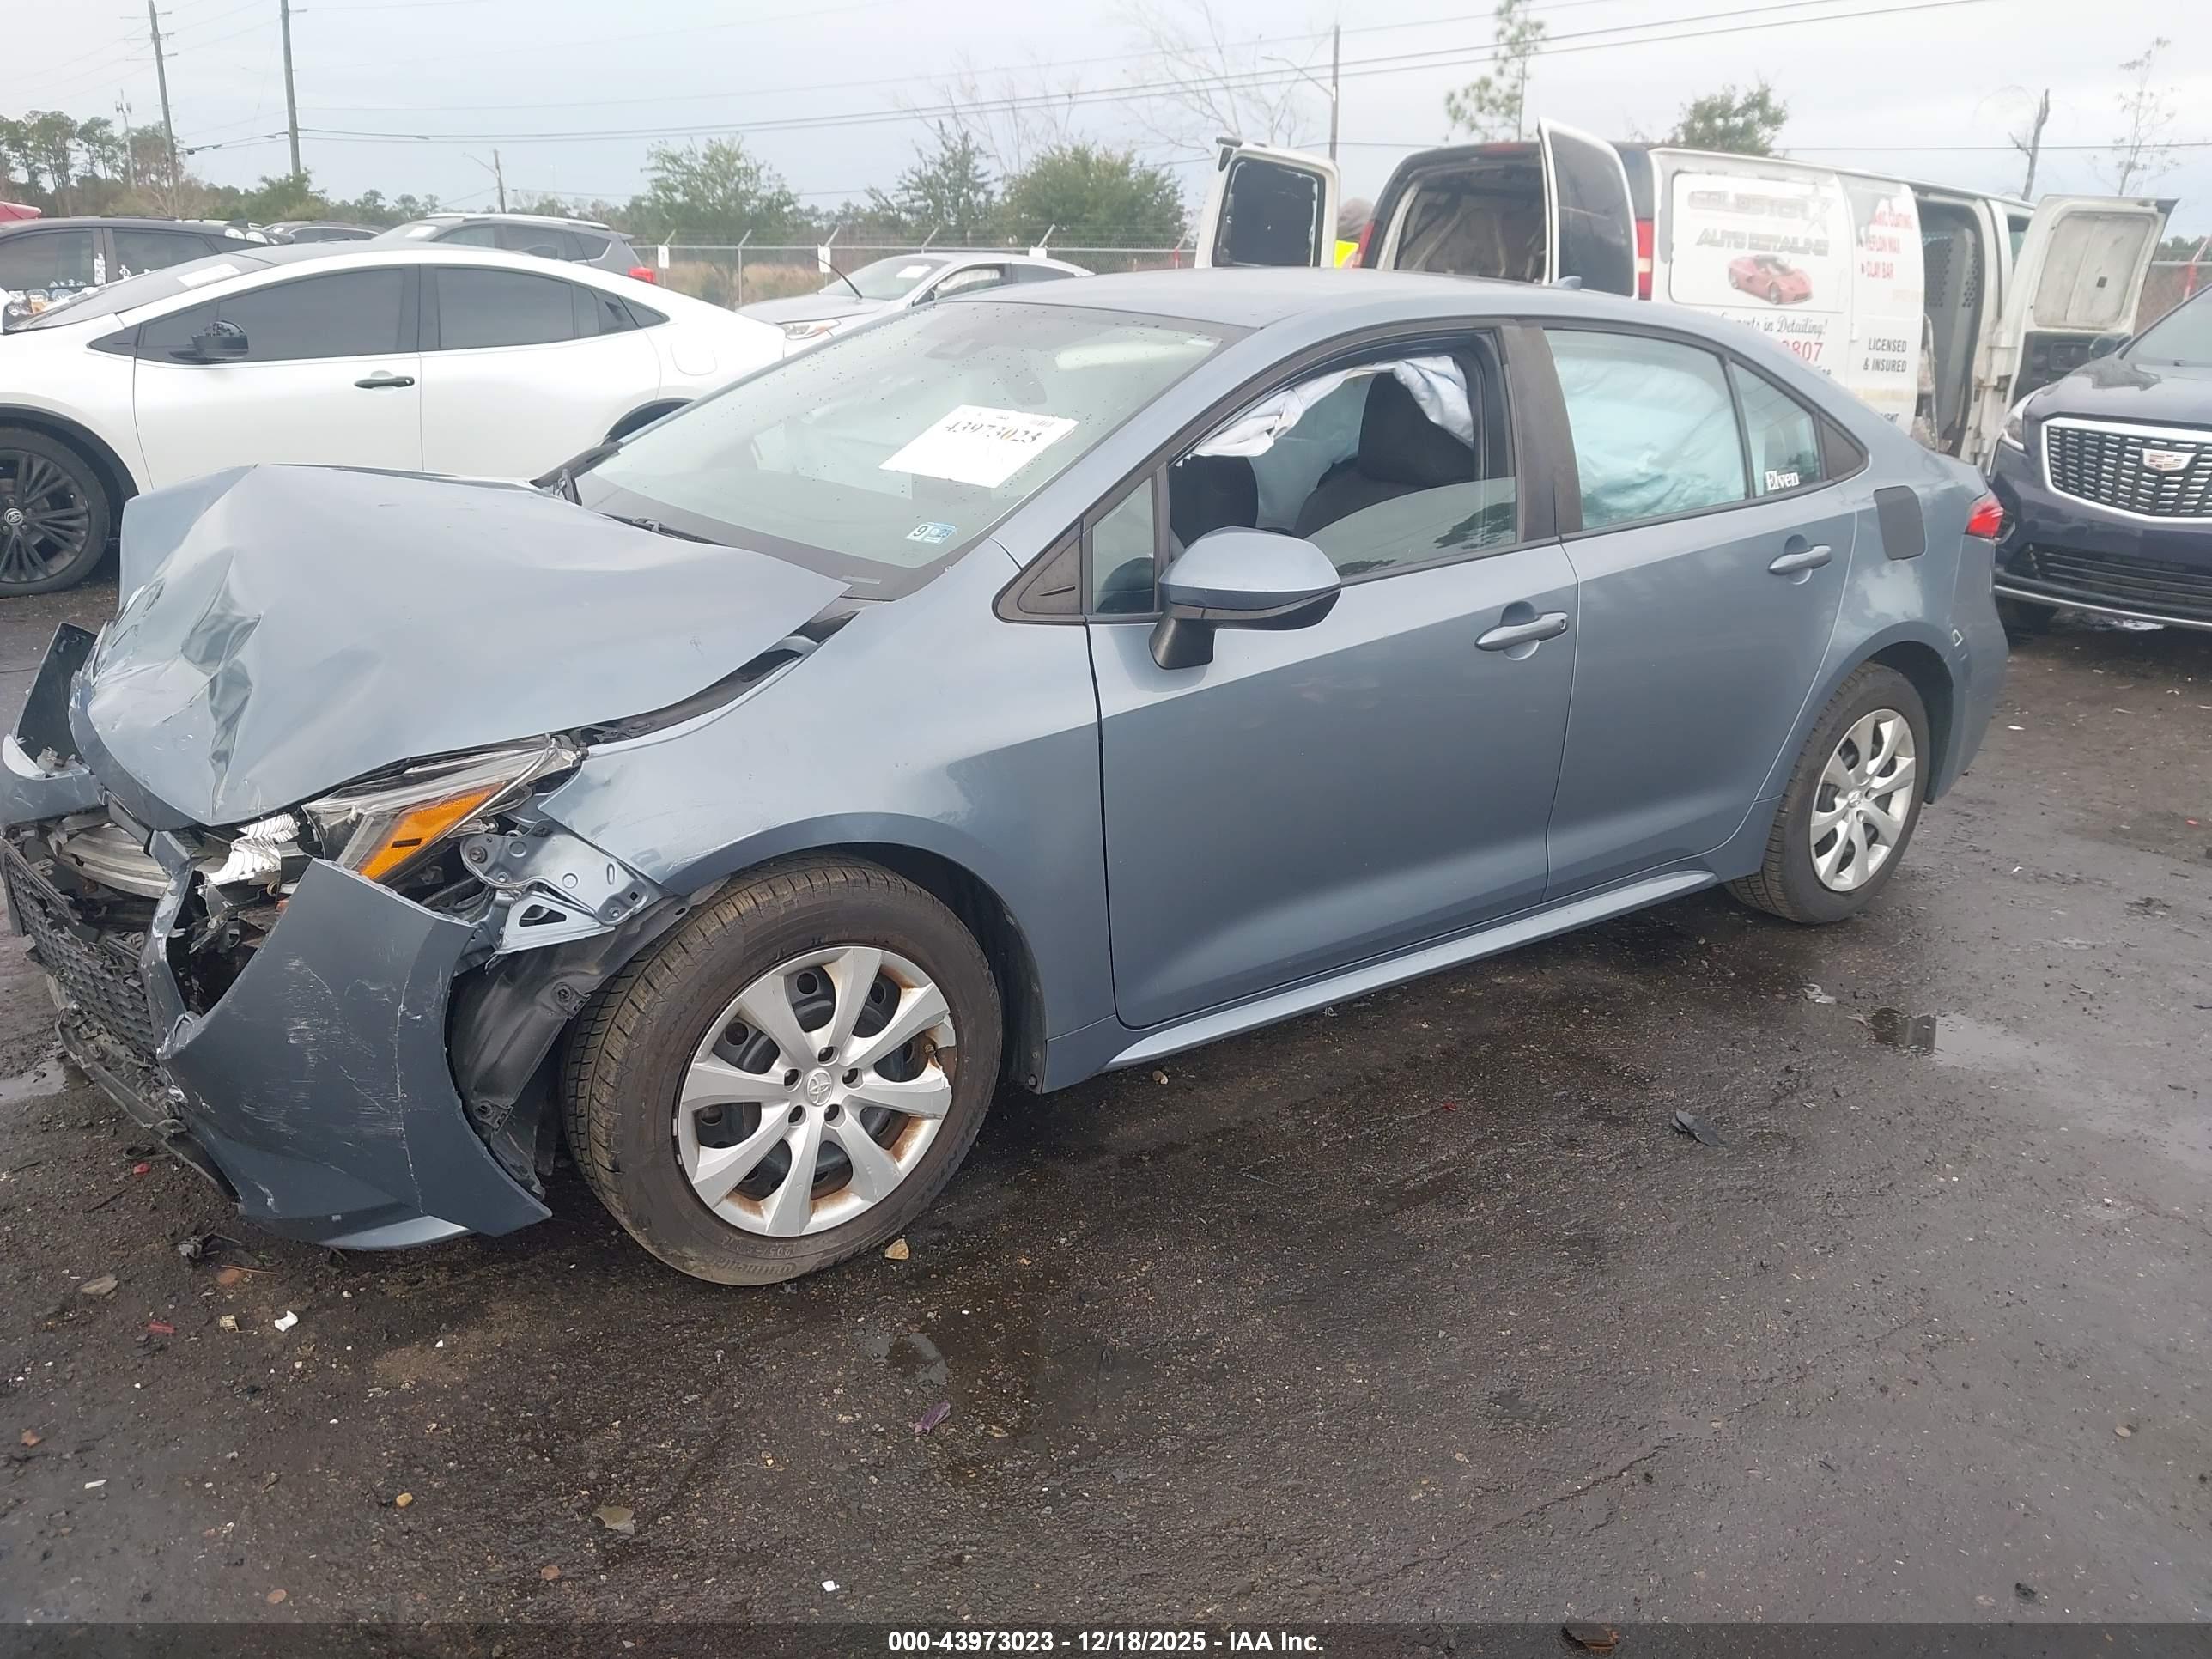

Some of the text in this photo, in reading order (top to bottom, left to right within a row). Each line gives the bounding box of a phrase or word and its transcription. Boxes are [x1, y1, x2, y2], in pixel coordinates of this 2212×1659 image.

[1777, 315, 1828, 338] Detailing!
[1868, 337, 1907, 352] LICENSED
[1863, 356, 1907, 373] & INSURED
[1765, 470, 1800, 491] Elven
[914, 525, 928, 537] 9
